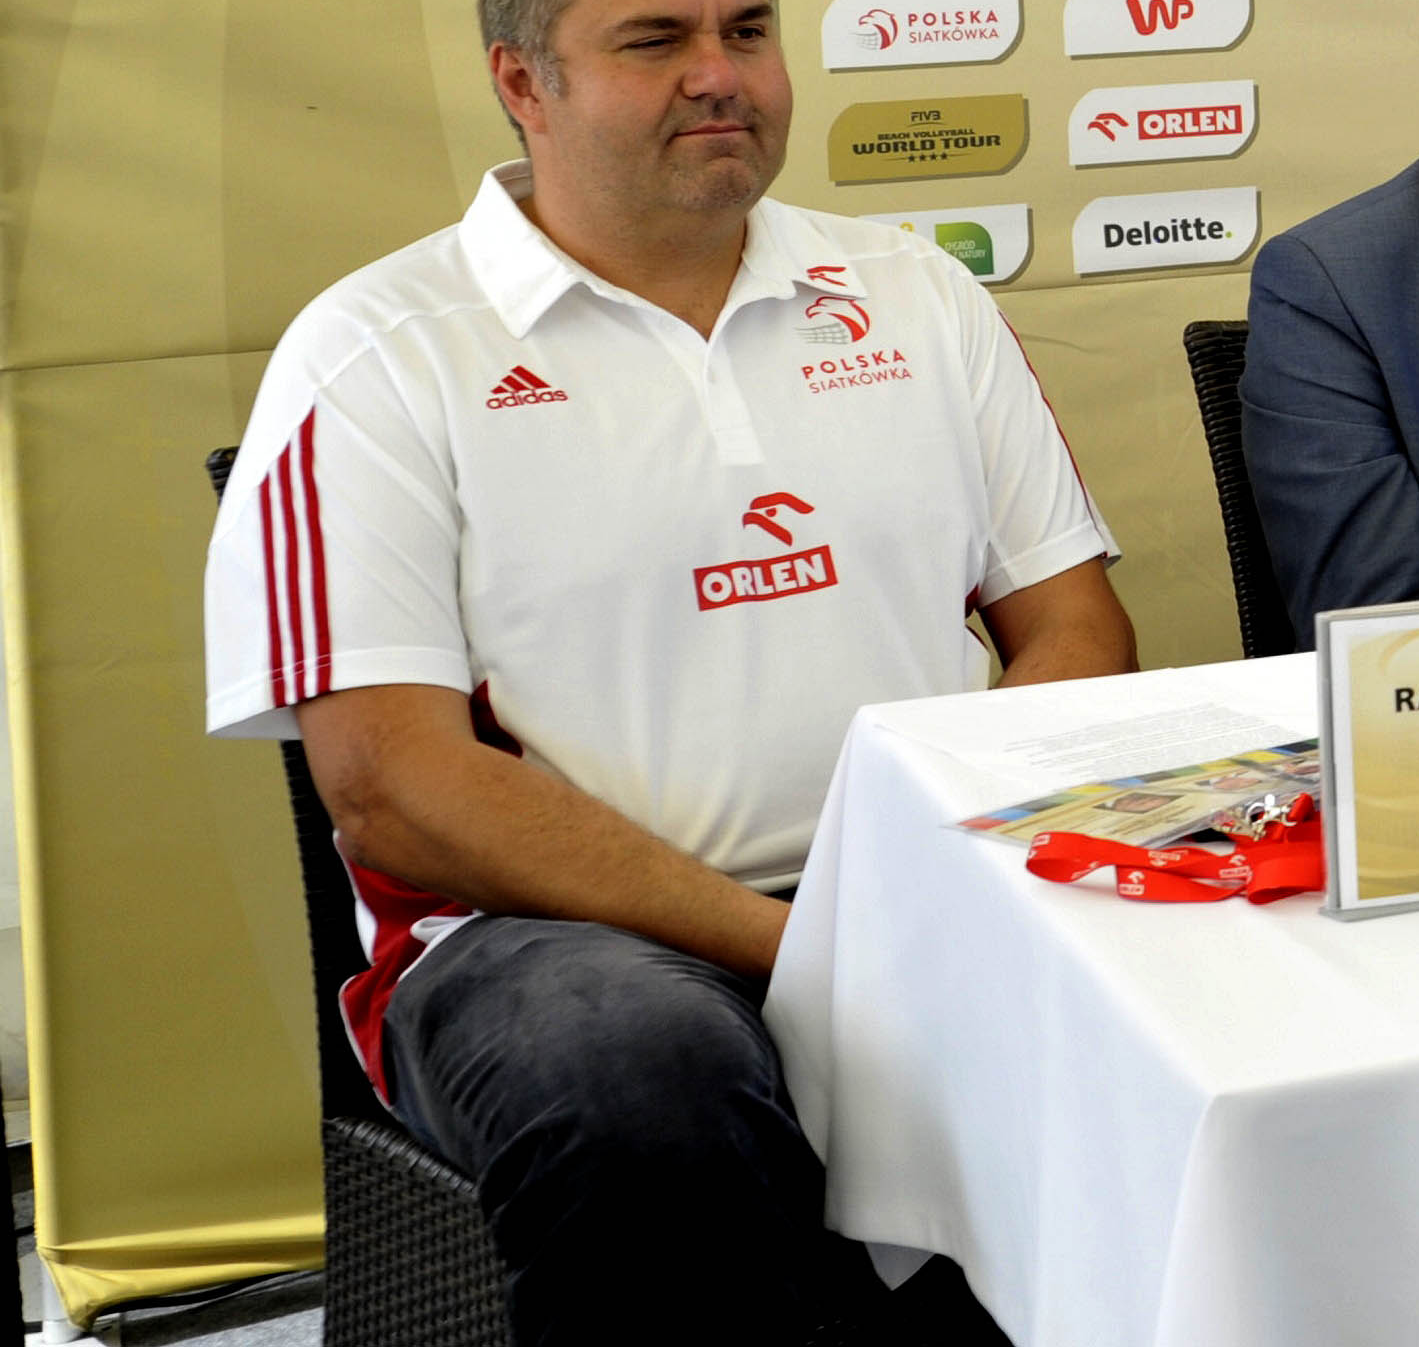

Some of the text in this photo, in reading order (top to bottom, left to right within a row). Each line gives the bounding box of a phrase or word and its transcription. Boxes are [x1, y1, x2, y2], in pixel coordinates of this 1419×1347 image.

[908, 11, 999, 27] POLSKA
[909, 27, 1000, 44] SIATKÓWKA
[910, 111, 941, 122] FIVB
[1144, 111, 1236, 136] ORLEN
[853, 135, 1001, 155] WORLD TOUR
[877, 128, 975, 141] BEACH VOLLEYBALL
[801, 349, 906, 380] POLSKA
[808, 369, 912, 394] SIATKÓWKA
[486, 388, 568, 410] adidas
[701, 554, 827, 604] ORLEN
